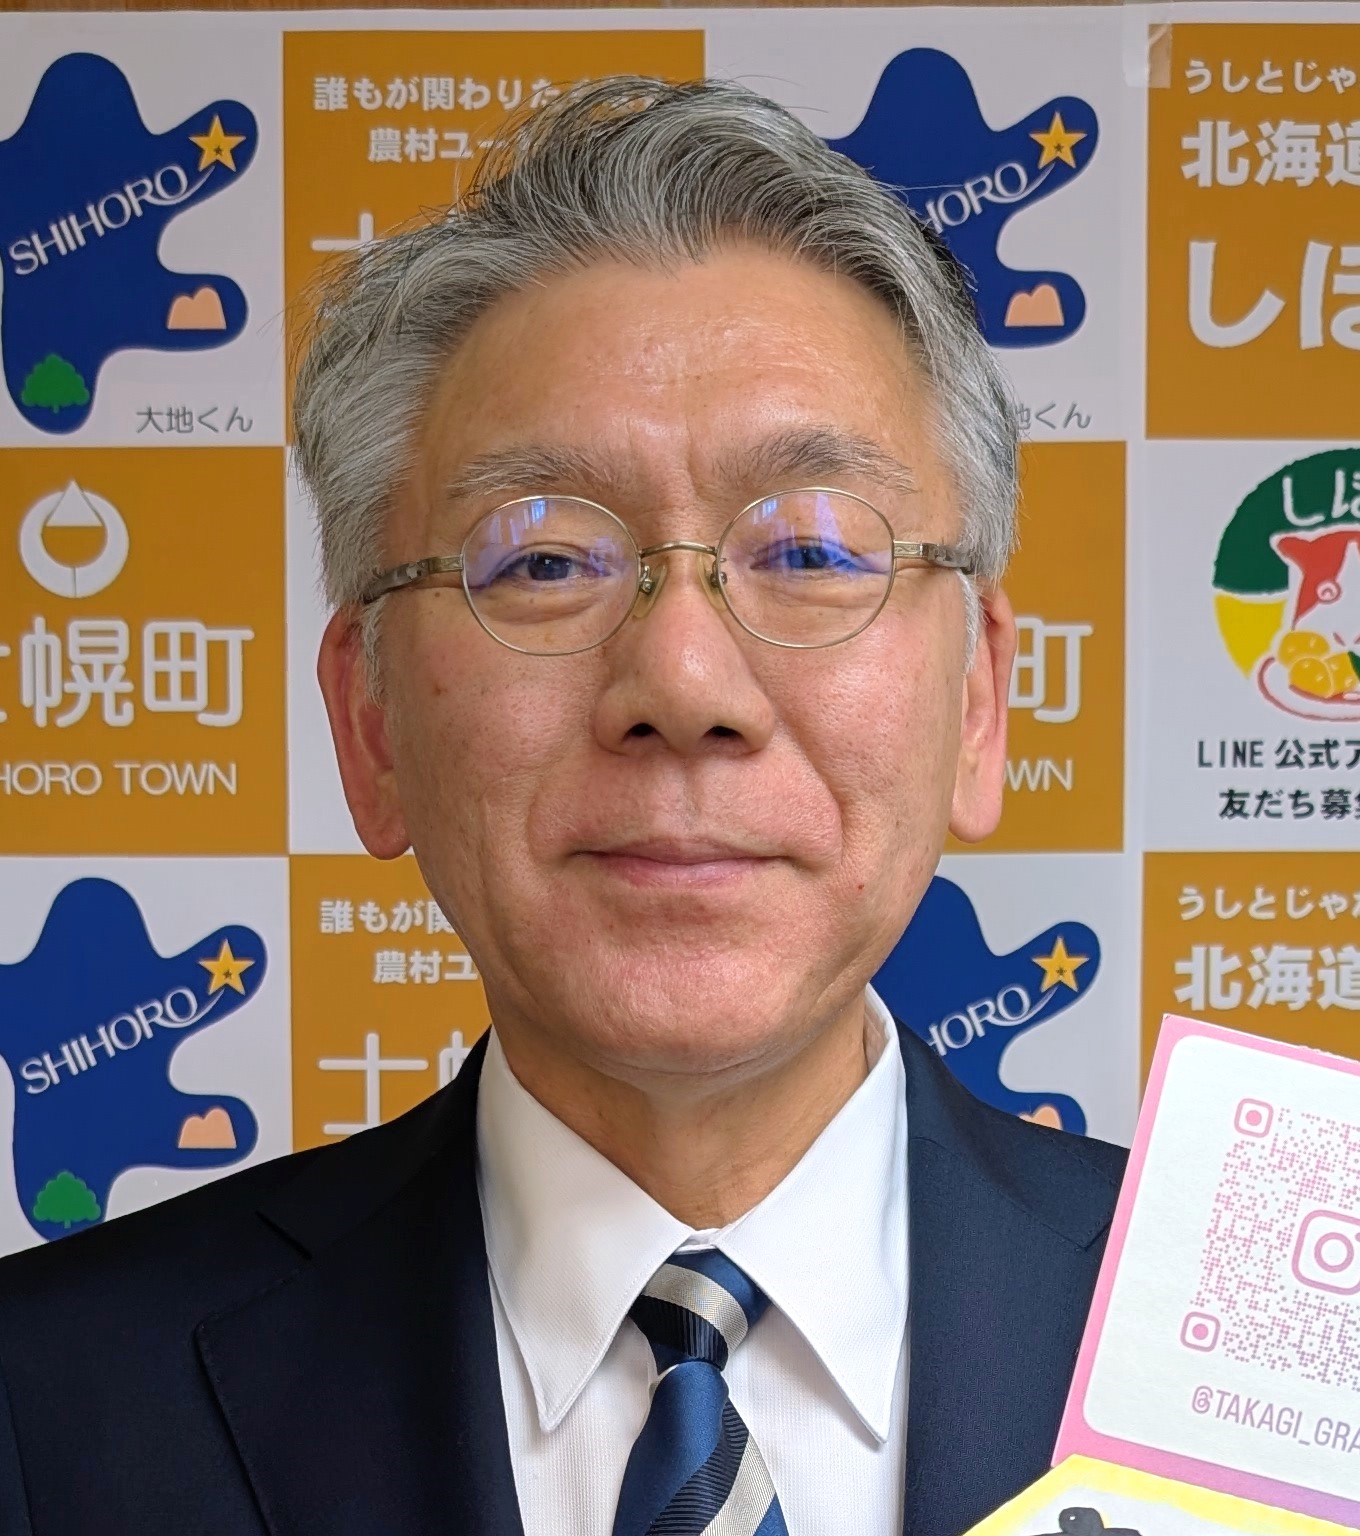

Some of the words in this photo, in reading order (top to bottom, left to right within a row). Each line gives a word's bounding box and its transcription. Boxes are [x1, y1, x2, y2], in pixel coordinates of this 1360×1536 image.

[8, 165, 188, 277] SHIHORO
[137, 406, 253, 433] 大地くん
[1199, 741, 1263, 767] LINE
[114, 762, 236, 795] TOWN
[1005, 758, 1074, 793] WN
[20, 987, 198, 1098] SHIHORO
